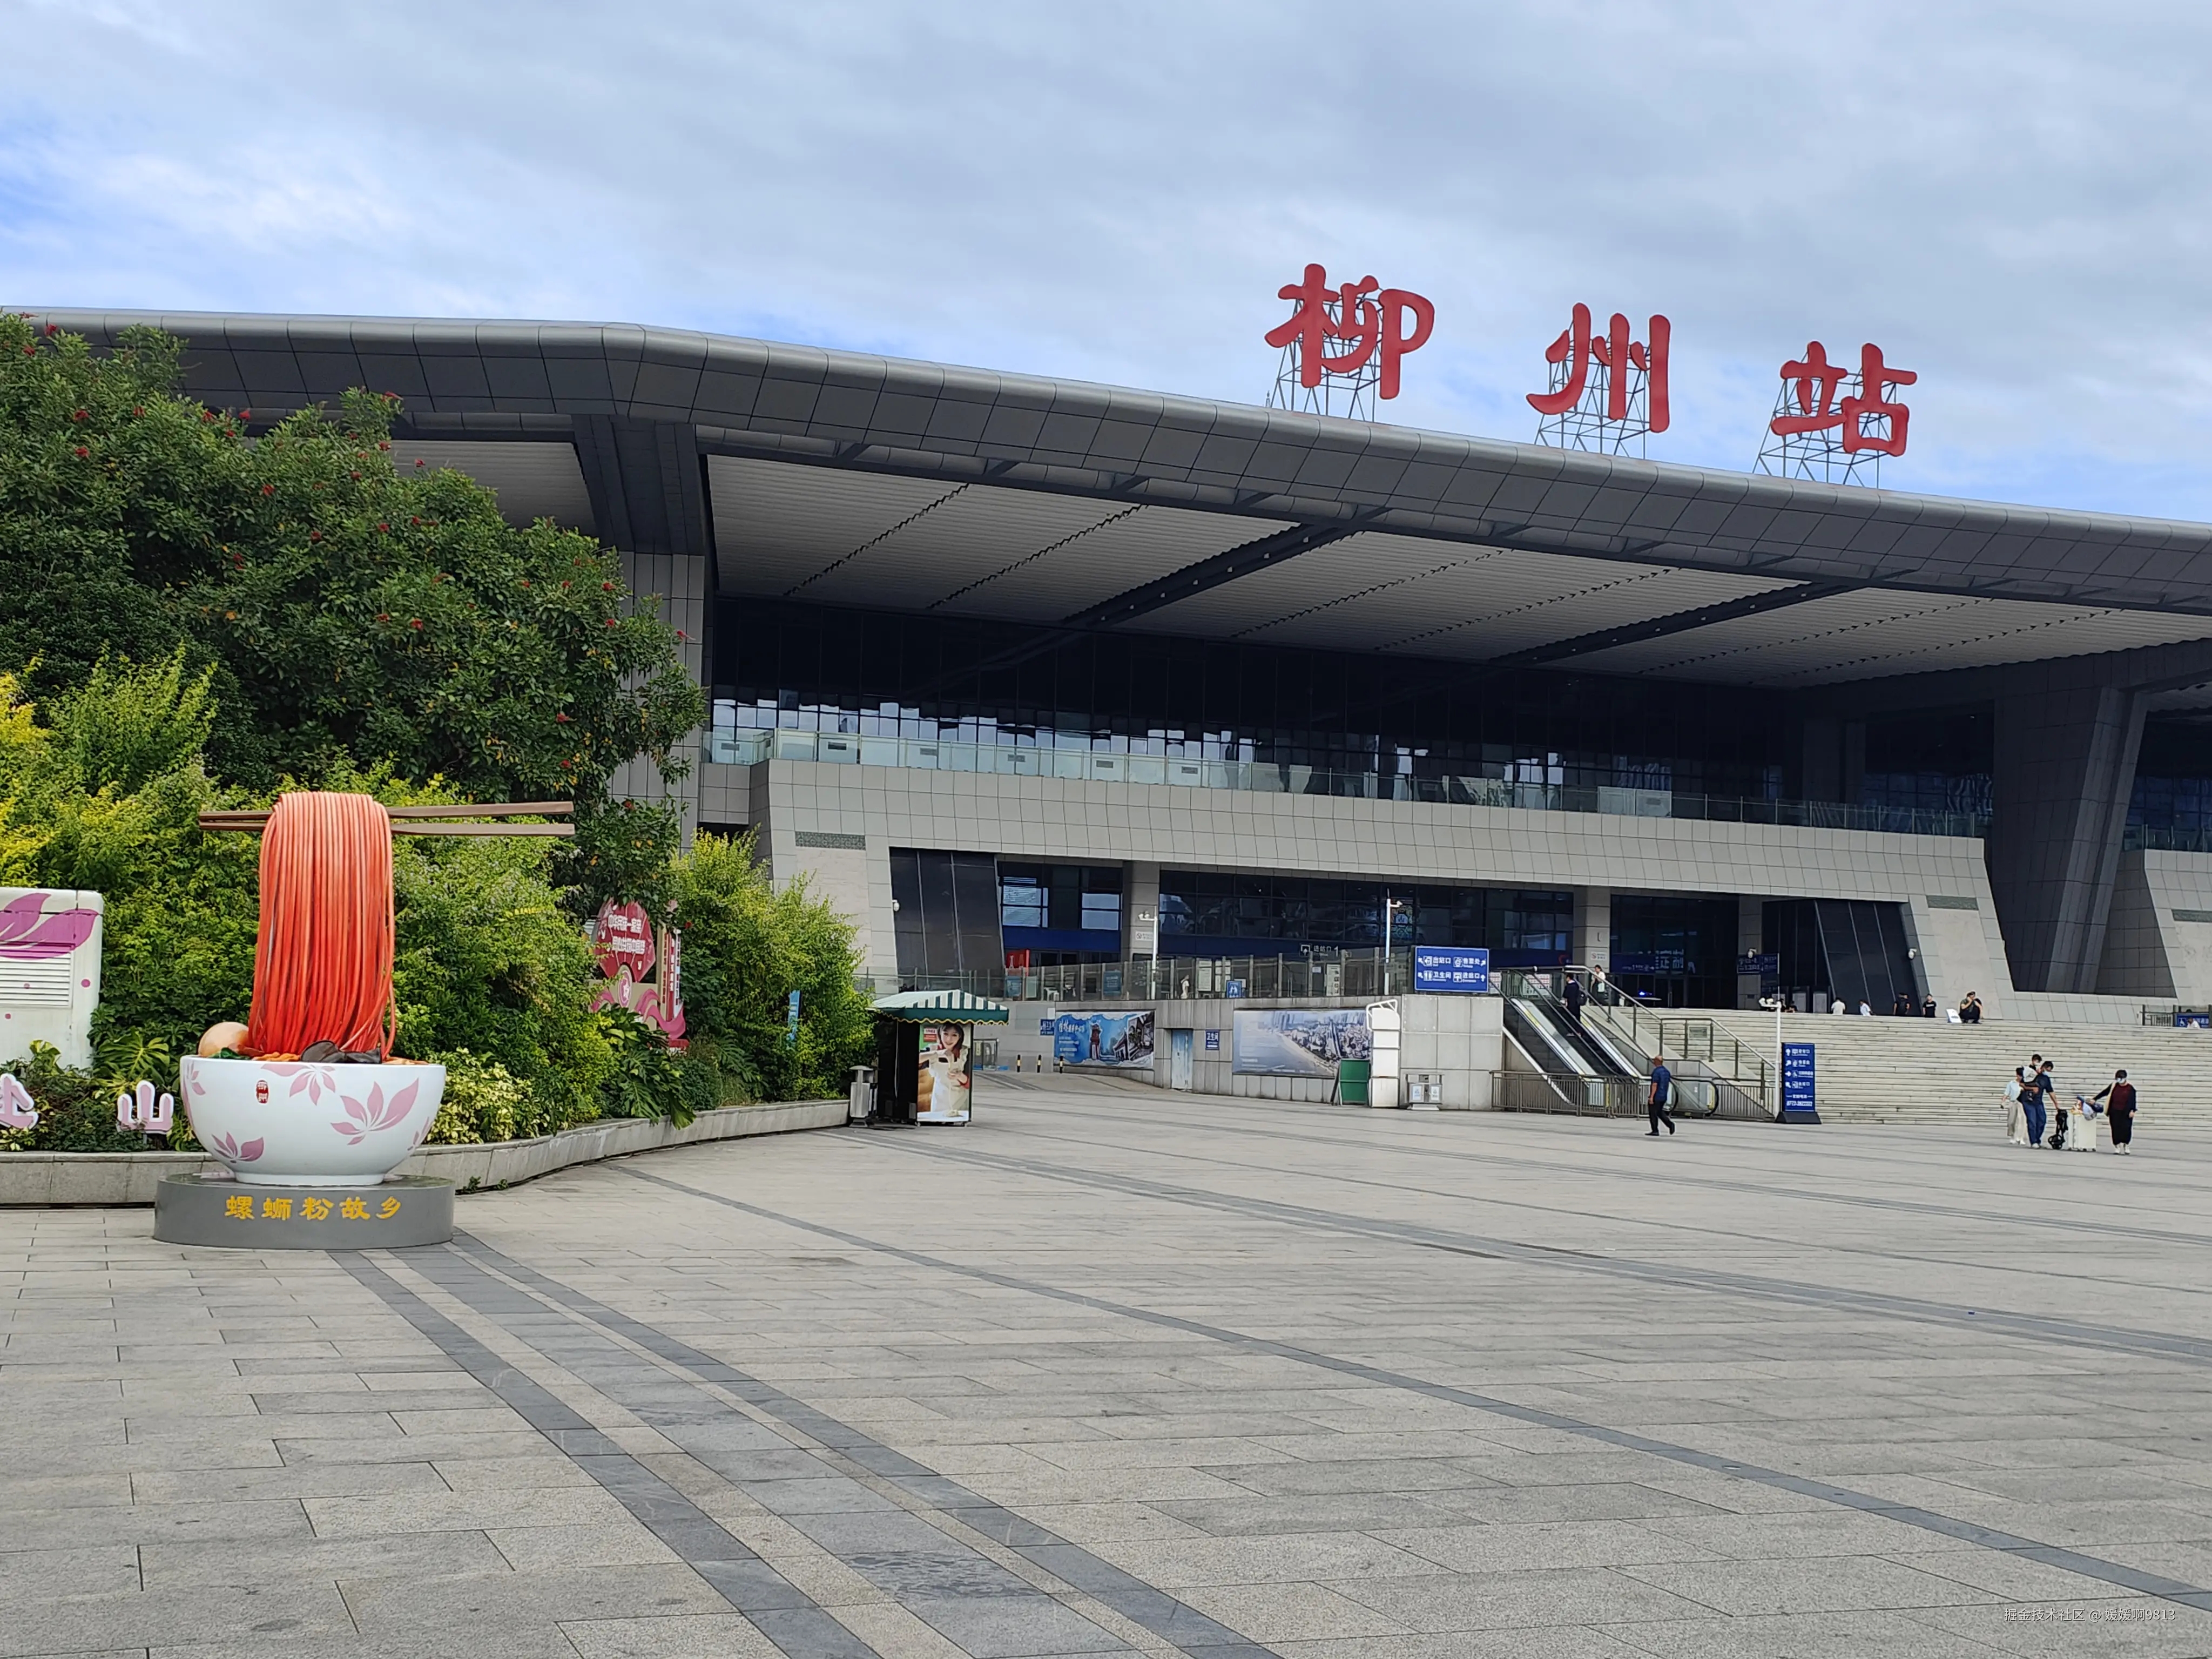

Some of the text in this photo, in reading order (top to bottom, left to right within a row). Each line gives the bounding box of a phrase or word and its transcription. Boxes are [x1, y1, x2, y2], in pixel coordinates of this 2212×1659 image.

[1264, 263, 1917, 456] 柳州站
[224, 1195, 402, 1220] 螺蛳粉故乡
